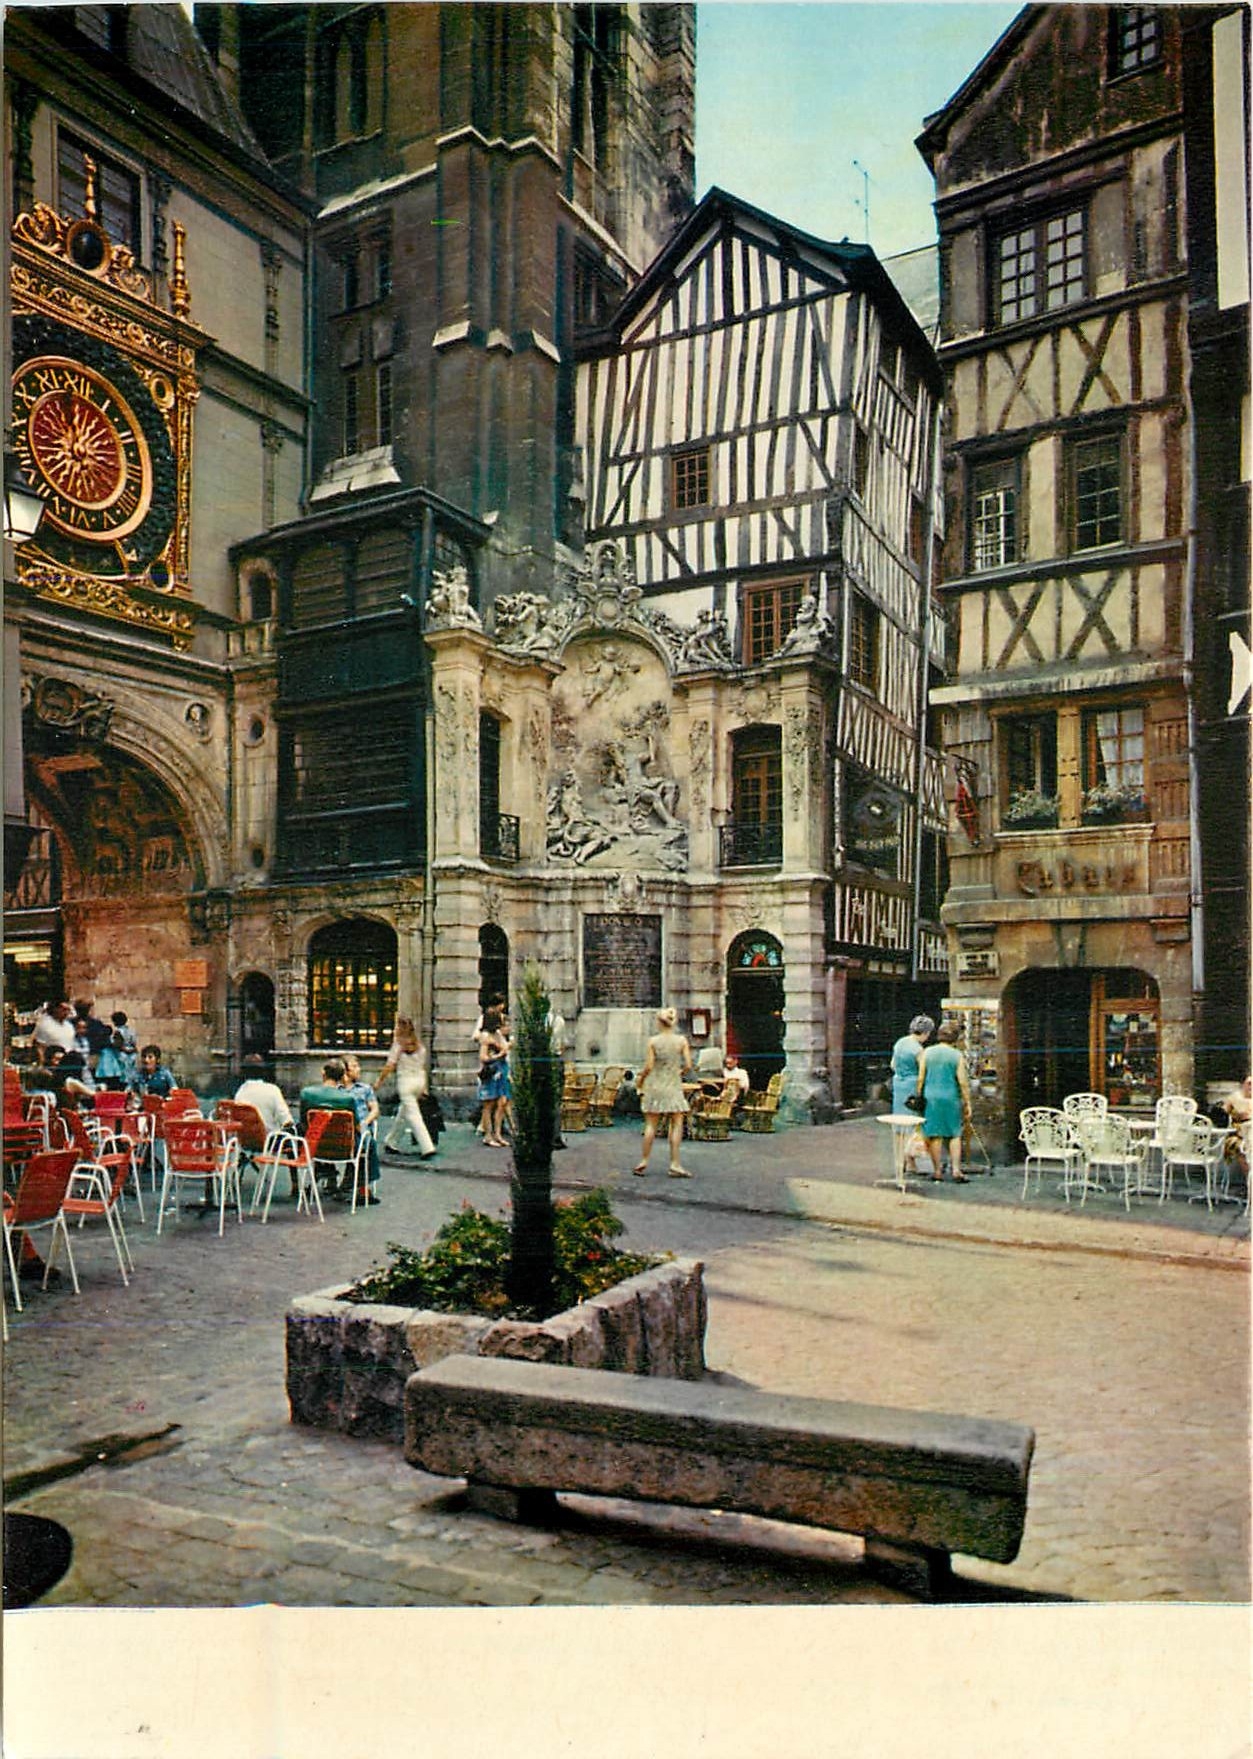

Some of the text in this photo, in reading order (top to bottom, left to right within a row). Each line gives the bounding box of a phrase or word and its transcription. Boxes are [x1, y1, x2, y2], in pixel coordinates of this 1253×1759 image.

[34, 369, 60, 392] XI
[64, 370, 90, 400] XII
[14, 382, 37, 409] X
[101, 399, 111, 412] I
[119, 430, 135, 444] II
[126, 462, 141, 483] III
[70, 506, 91, 529] VI
[103, 511, 118, 529] V
